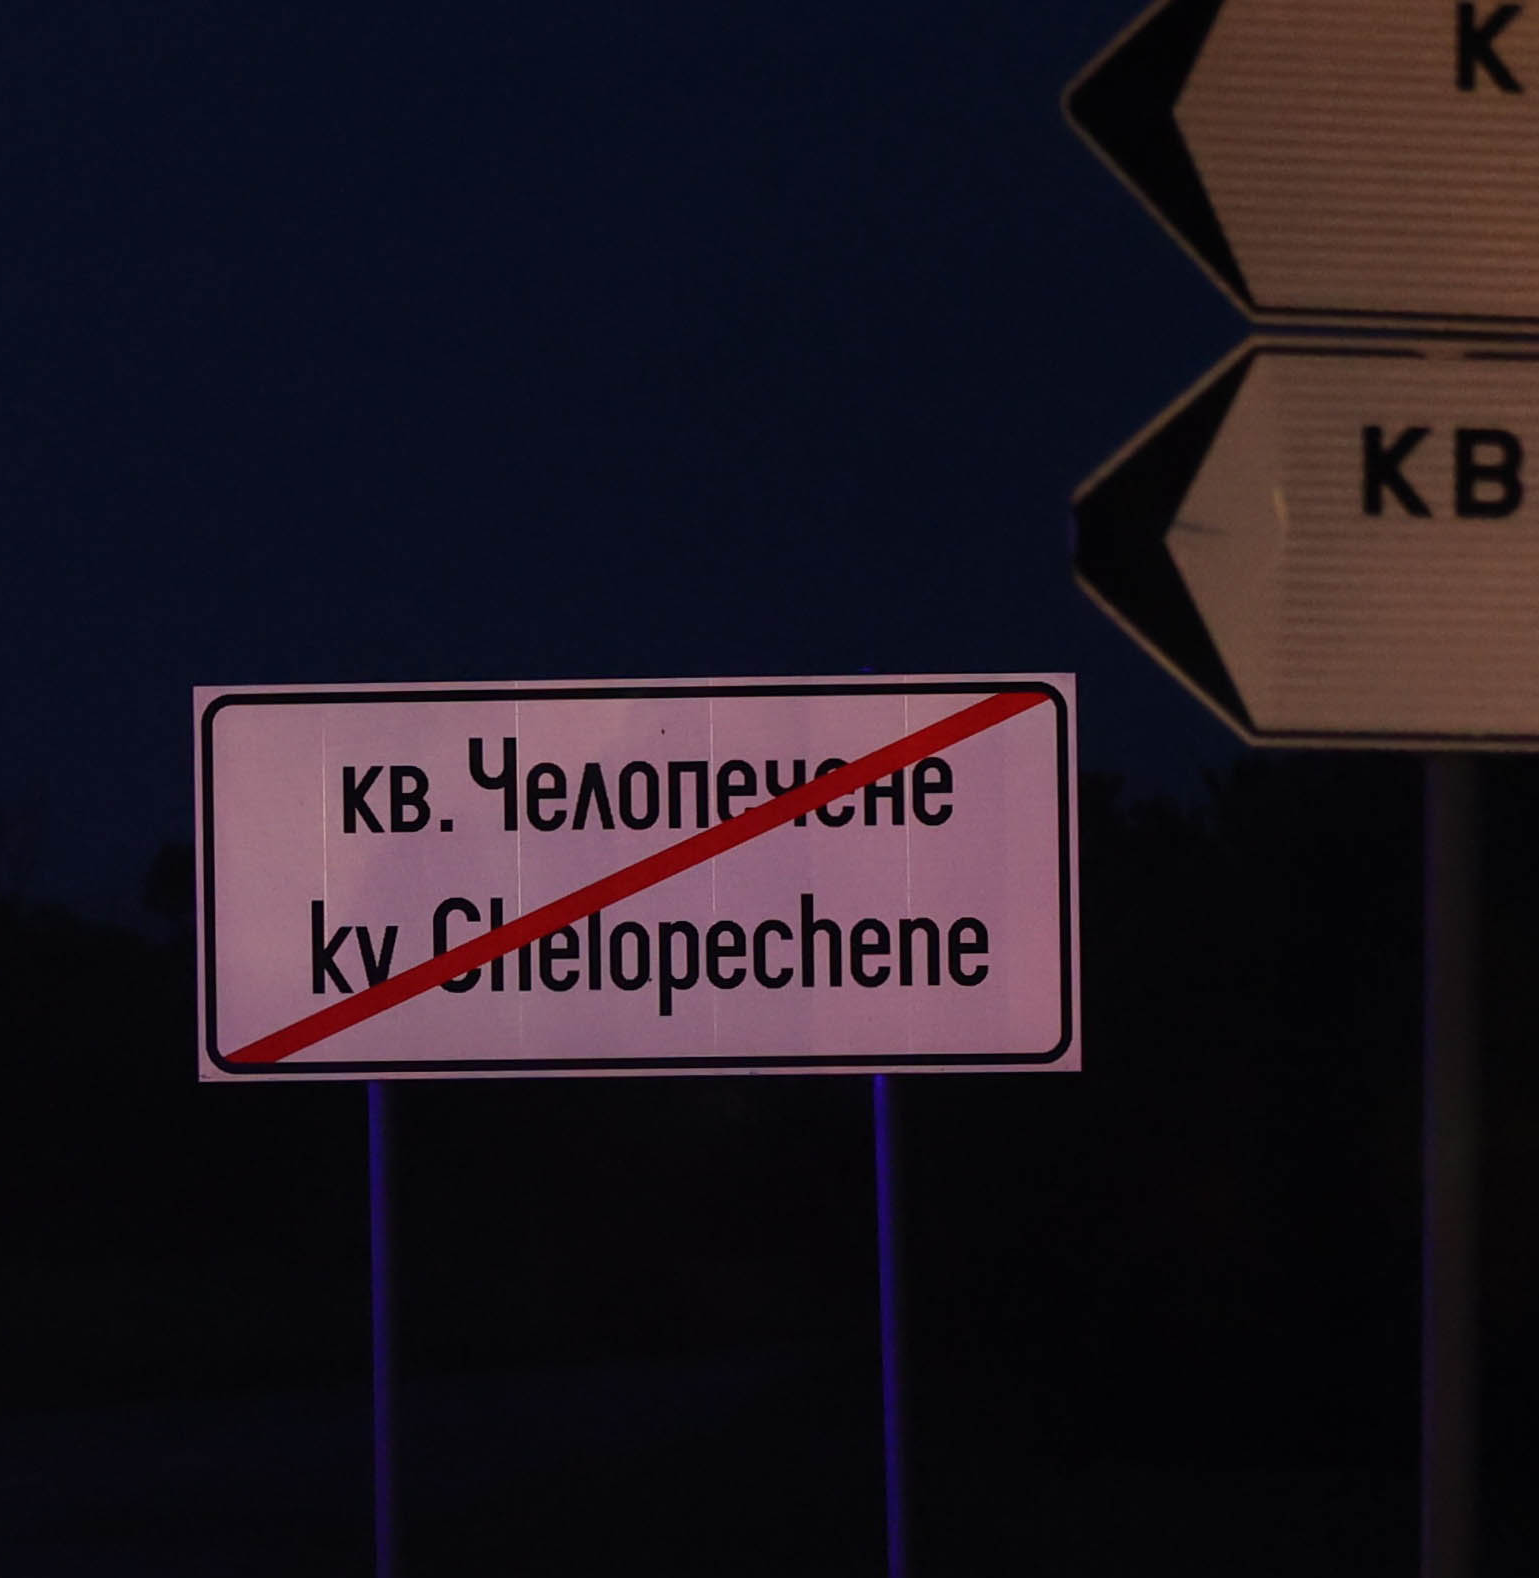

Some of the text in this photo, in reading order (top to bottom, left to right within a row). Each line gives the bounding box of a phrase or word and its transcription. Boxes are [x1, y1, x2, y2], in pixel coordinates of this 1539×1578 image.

[468, 737, 955, 833] Челопечене
[311, 892, 991, 1018] kv Chelopechene
